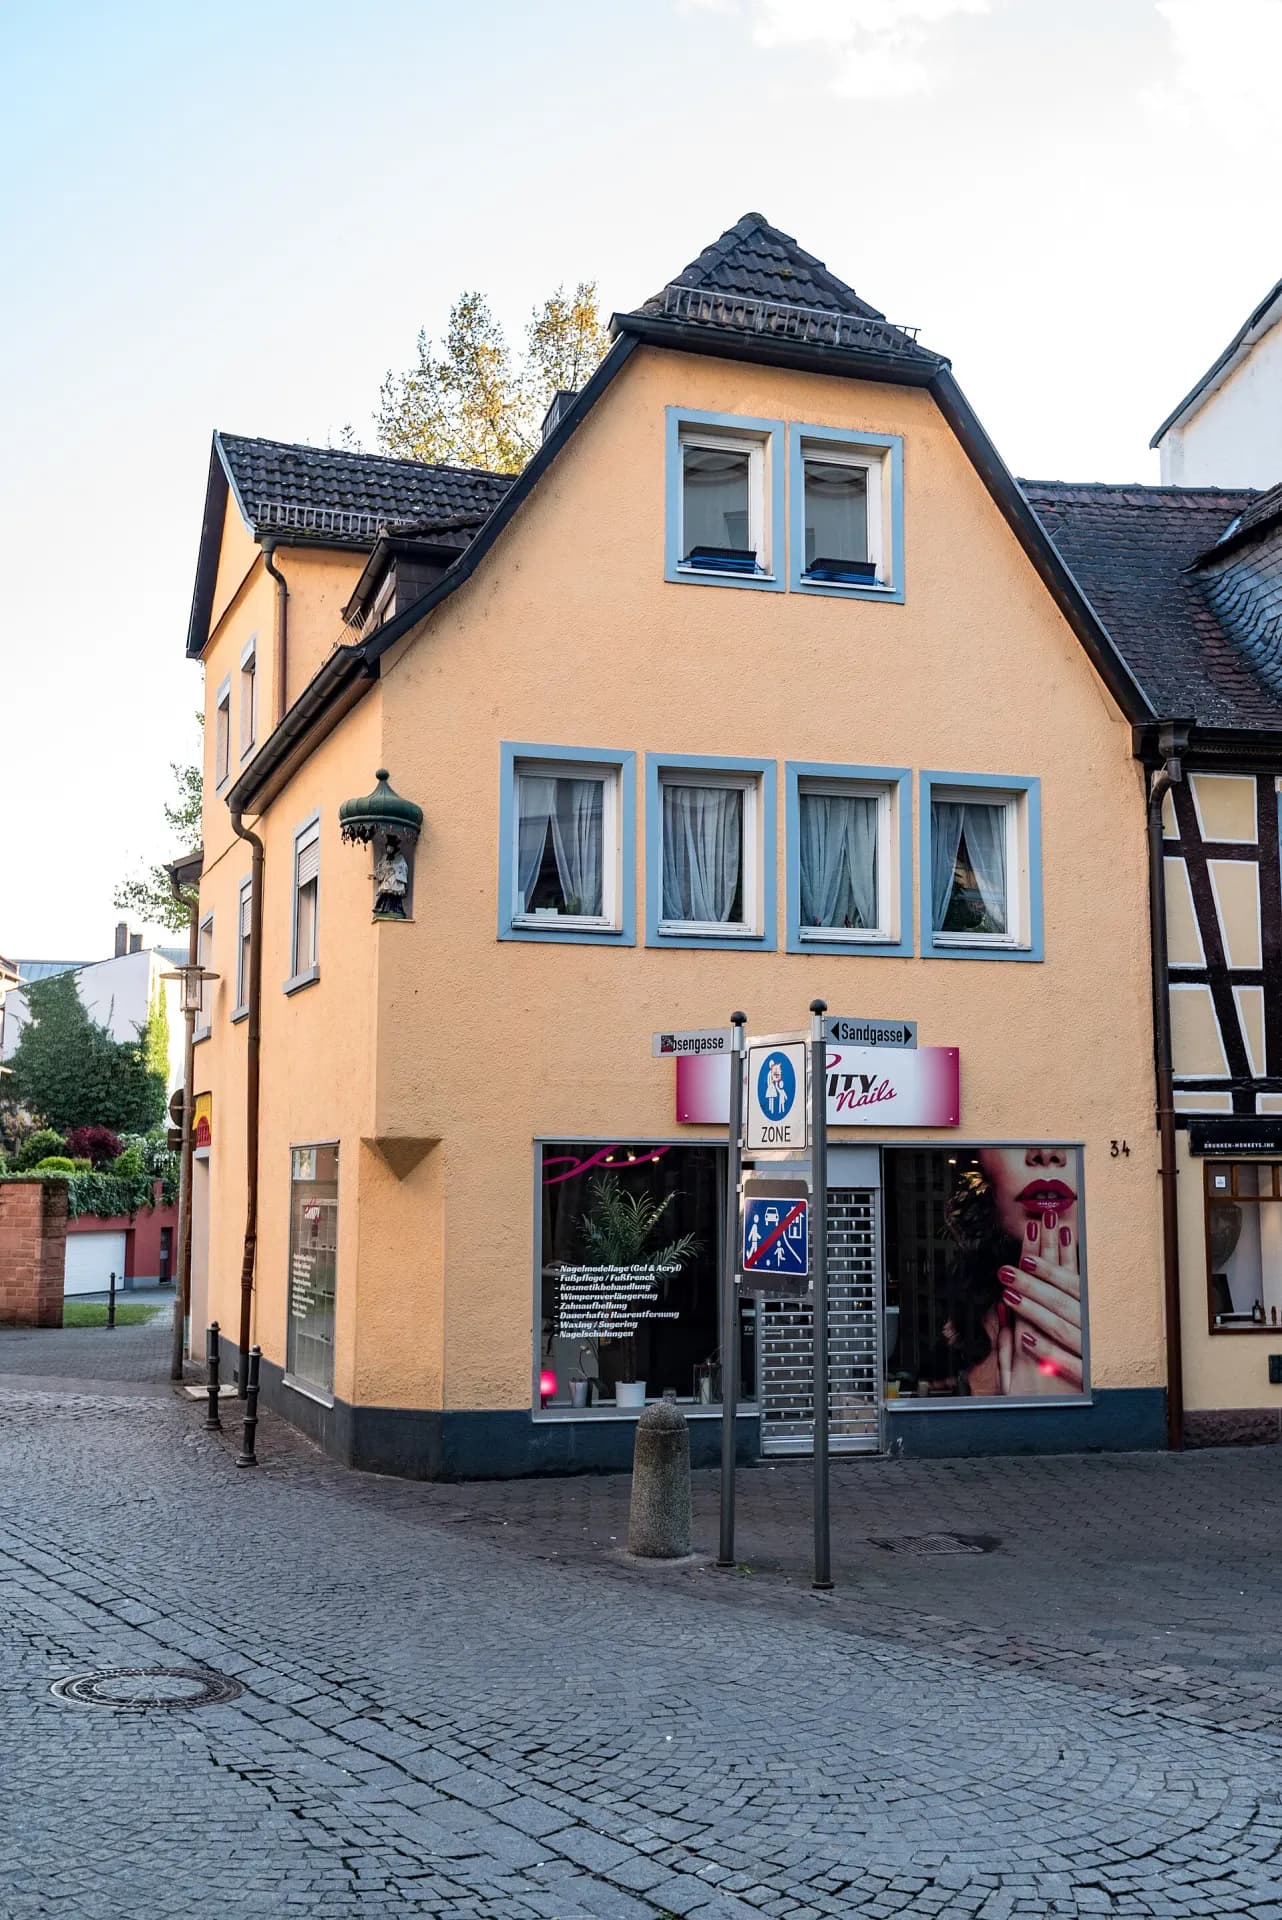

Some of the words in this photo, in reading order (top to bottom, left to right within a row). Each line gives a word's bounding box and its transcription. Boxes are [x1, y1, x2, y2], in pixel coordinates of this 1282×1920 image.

[841, 1023, 903, 1045] Sandgasse
[667, 1037, 724, 1054] osengasse
[836, 1080, 898, 1112] Nails
[761, 1126, 791, 1142] ZONE
[1110, 1140, 1131, 1157] 34
[560, 1265, 630, 1274] Nagelmodellage
[630, 1264, 648, 1272] (Gel
[656, 1264, 682, 1273] Acryl)
[560, 1274, 604, 1283] Fußpflege
[610, 1273, 656, 1281] Fußfrench
[560, 1283, 652, 1292] Kosmetikbehandlung
[560, 1292, 658, 1301] Wimpernverlängerung
[560, 1302, 628, 1310] Zahnaufhellung
[560, 1311, 610, 1319] Dauerhafte
[610, 1310, 680, 1319] Haarentfernung
[560, 1321, 593, 1330] Waxing
[560, 1330, 634, 1339] Nagelschulungen
